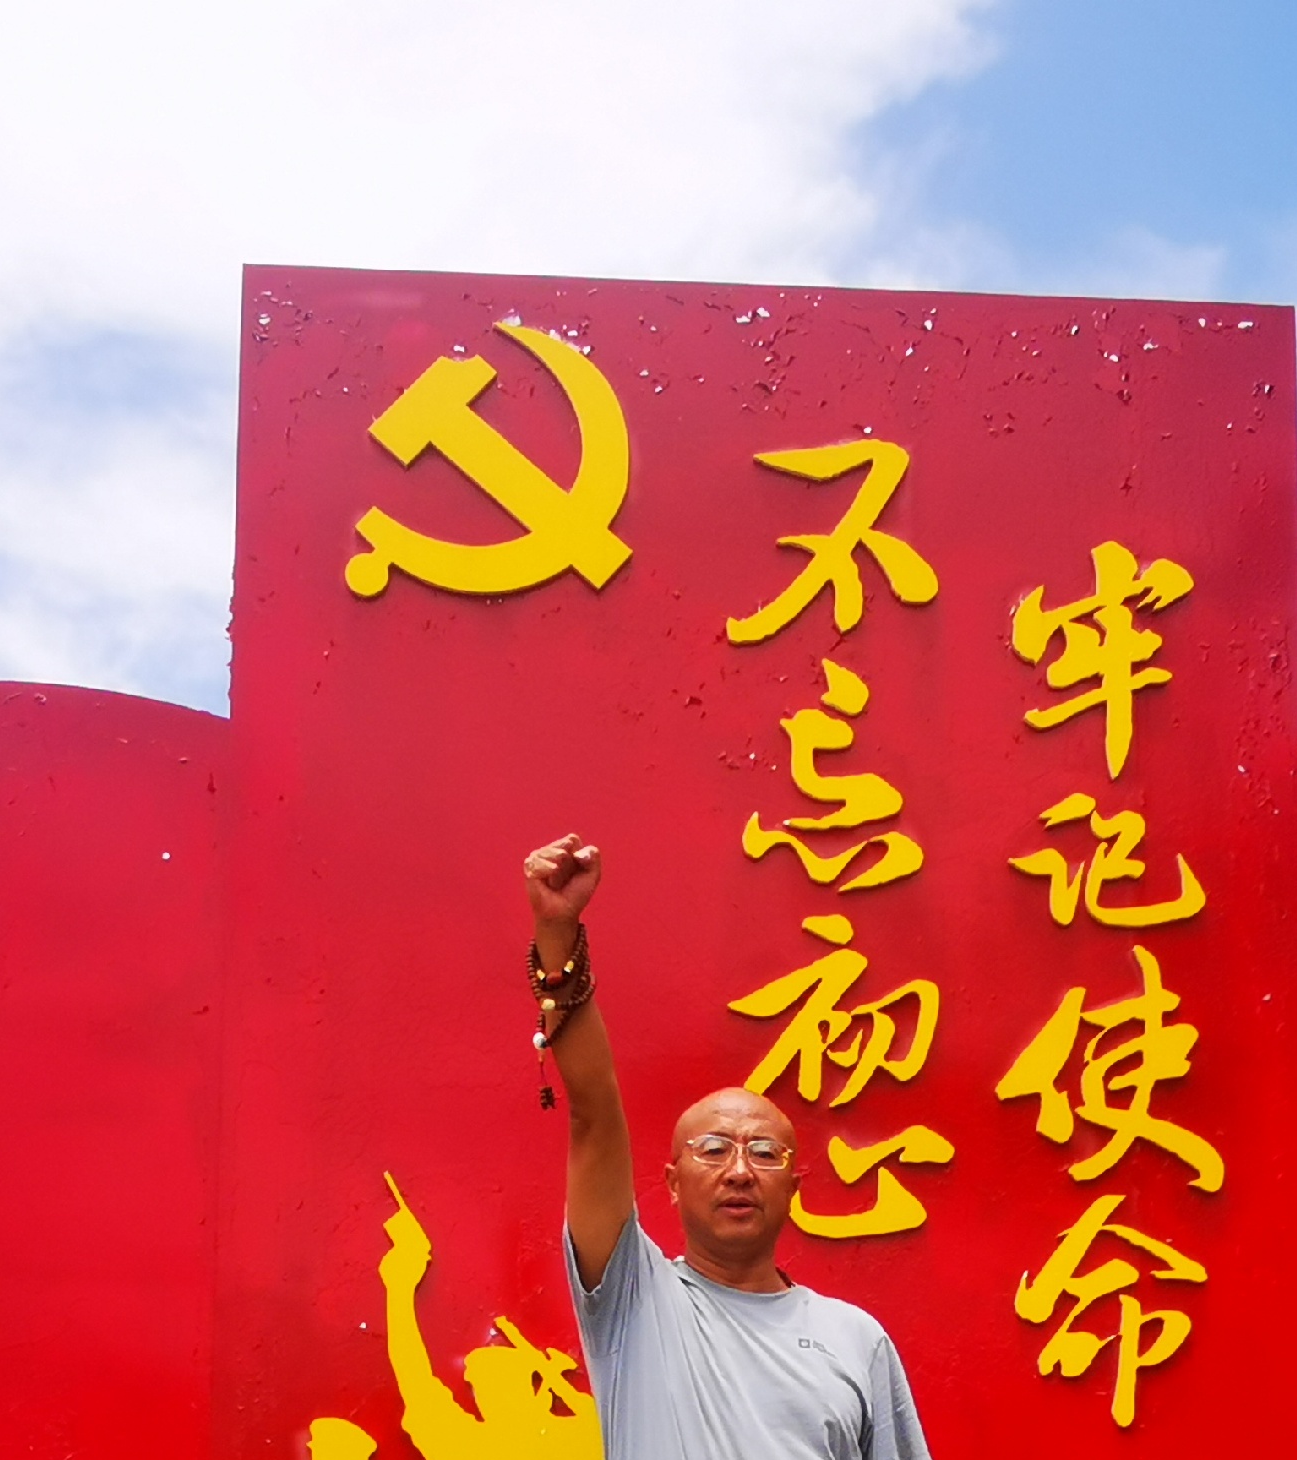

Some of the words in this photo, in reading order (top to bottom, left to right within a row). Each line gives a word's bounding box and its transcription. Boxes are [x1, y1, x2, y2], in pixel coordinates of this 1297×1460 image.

[724, 437, 956, 1240] 不忘初心
[994, 539, 1226, 1428] 牢记使命
